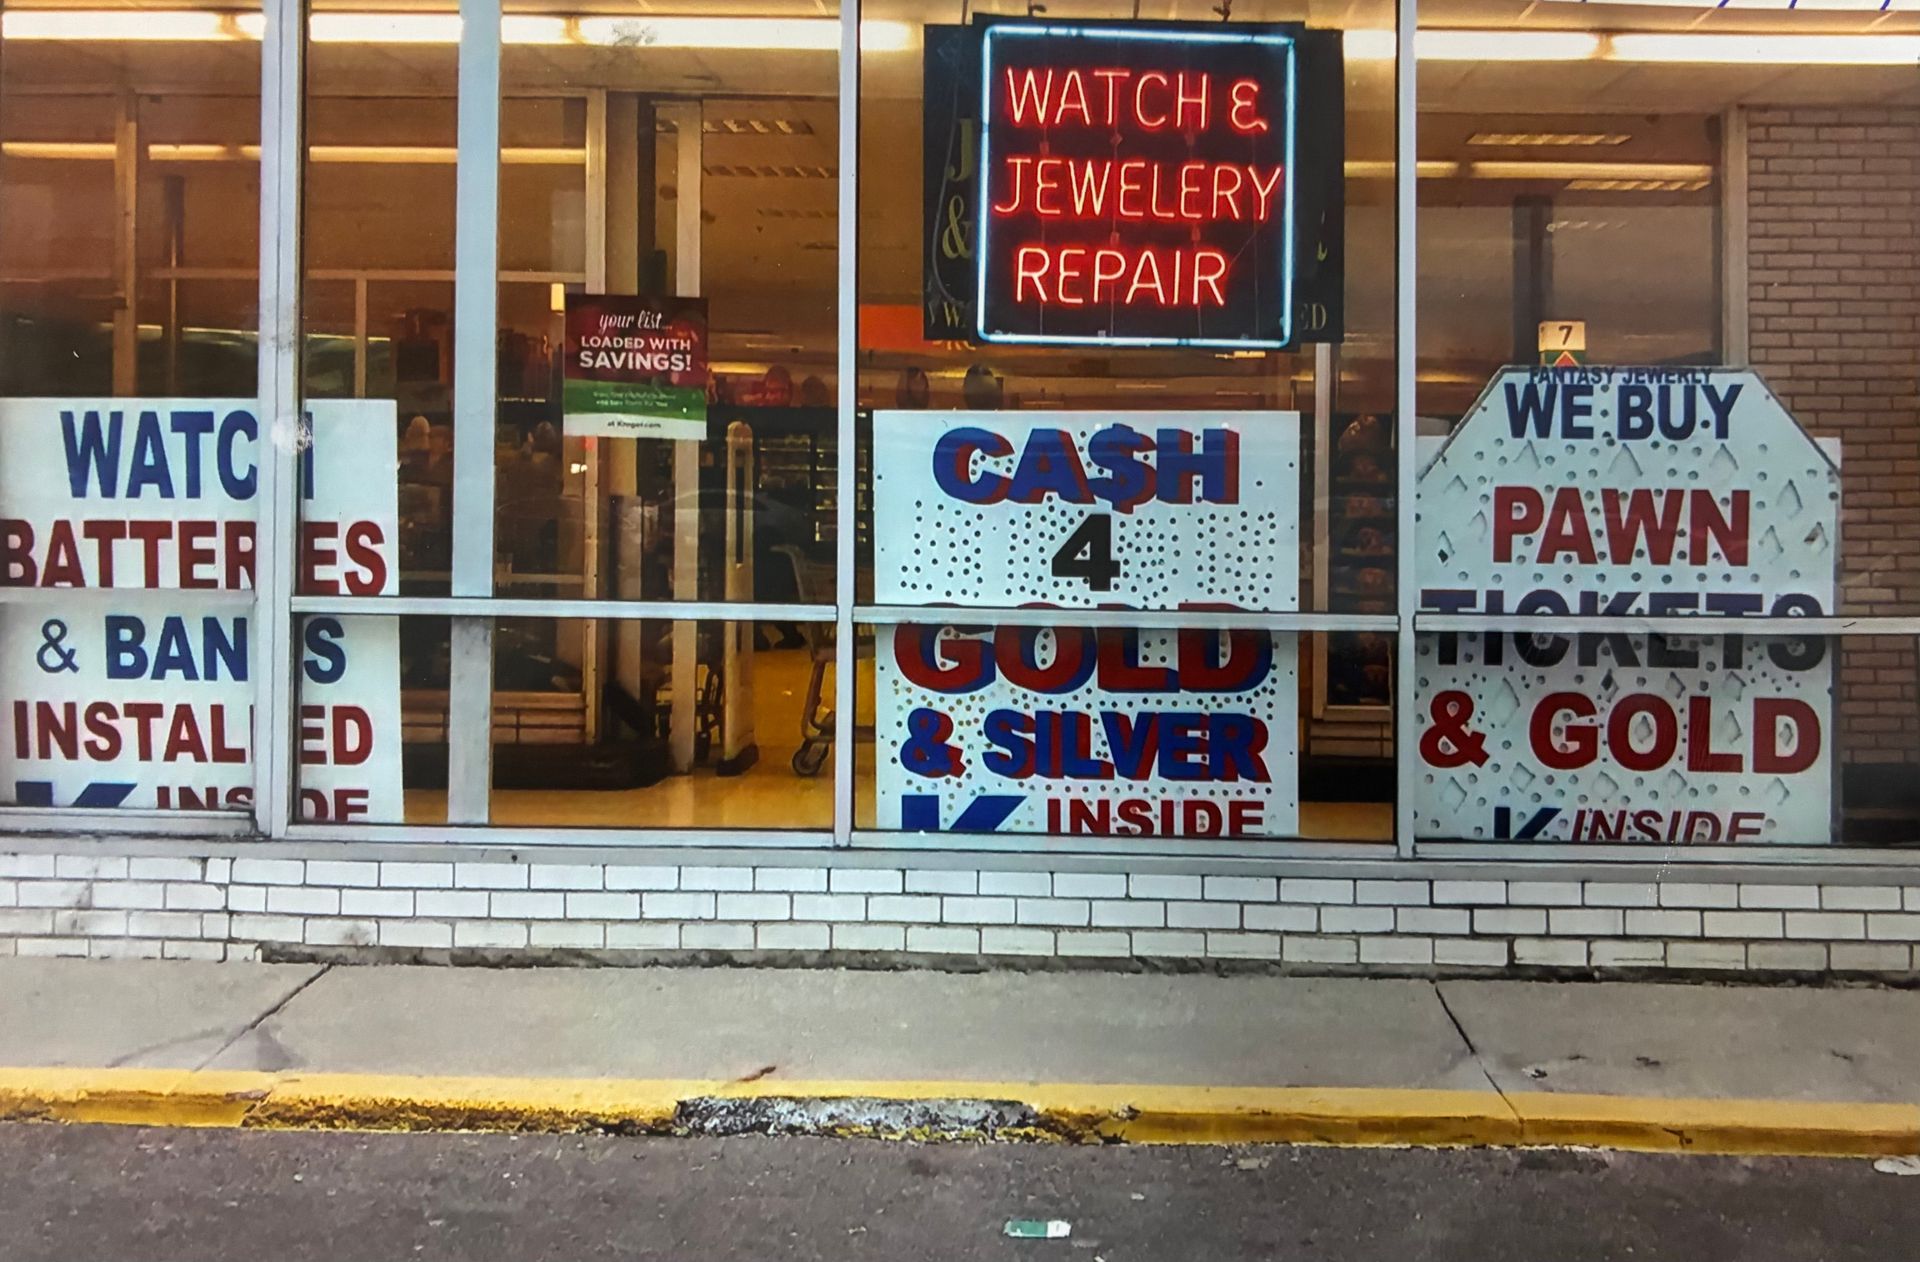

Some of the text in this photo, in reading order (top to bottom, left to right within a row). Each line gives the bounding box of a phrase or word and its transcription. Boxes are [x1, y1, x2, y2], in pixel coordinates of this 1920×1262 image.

[1006, 66, 1269, 133] WATCH &
[993, 157, 1283, 222] JEWELERY
[1015, 246, 1227, 306] REPAIR
[580, 335, 691, 351] LOADED WITH
[598, 314, 635, 336] your
[1558, 325, 1573, 346] 7
[579, 350, 692, 372] SAVINGS!
[1529, 366, 1617, 385] FANTASY
[1504, 382, 1744, 441] WE BUY
[60, 410, 314, 500] WATC
[932, 423, 1240, 515] CA$H
[0, 518, 388, 596] BATTERES
[1051, 513, 1121, 592] 4
[1492, 485, 1751, 567] PAWN
[36, 614, 347, 684] & BANS
[893, 602, 1273, 695] GOLD
[1420, 588, 1827, 672] TICKETS
[13, 700, 374, 766] INSTALED
[899, 707, 1272, 783] & SILVER
[1419, 690, 1822, 775] & GOLD
